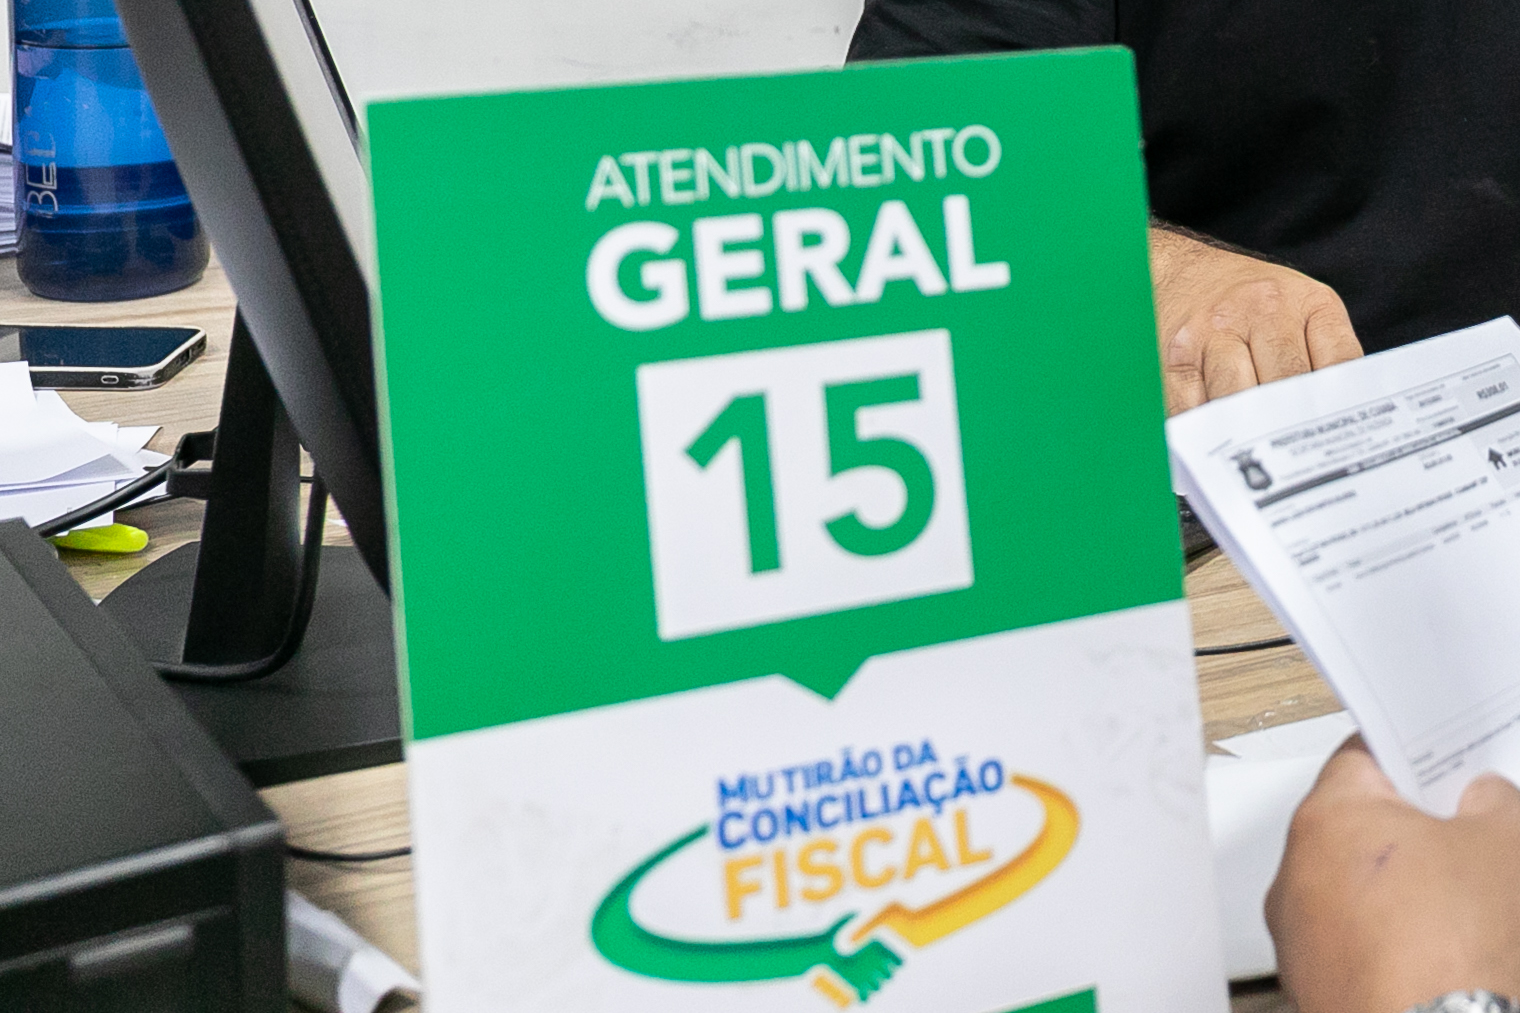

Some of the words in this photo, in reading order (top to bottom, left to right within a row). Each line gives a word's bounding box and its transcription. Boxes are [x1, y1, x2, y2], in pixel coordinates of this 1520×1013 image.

[584, 124, 1002, 212] ATENDIMENTO
[586, 194, 1010, 332] GERAL
[683, 371, 936, 578] 15
[718, 755, 1003, 850] CONCILIAÇÃO
[719, 746, 883, 810] MUTIRÃO
[893, 740, 938, 771] DA
[725, 808, 992, 921] FISCAL
